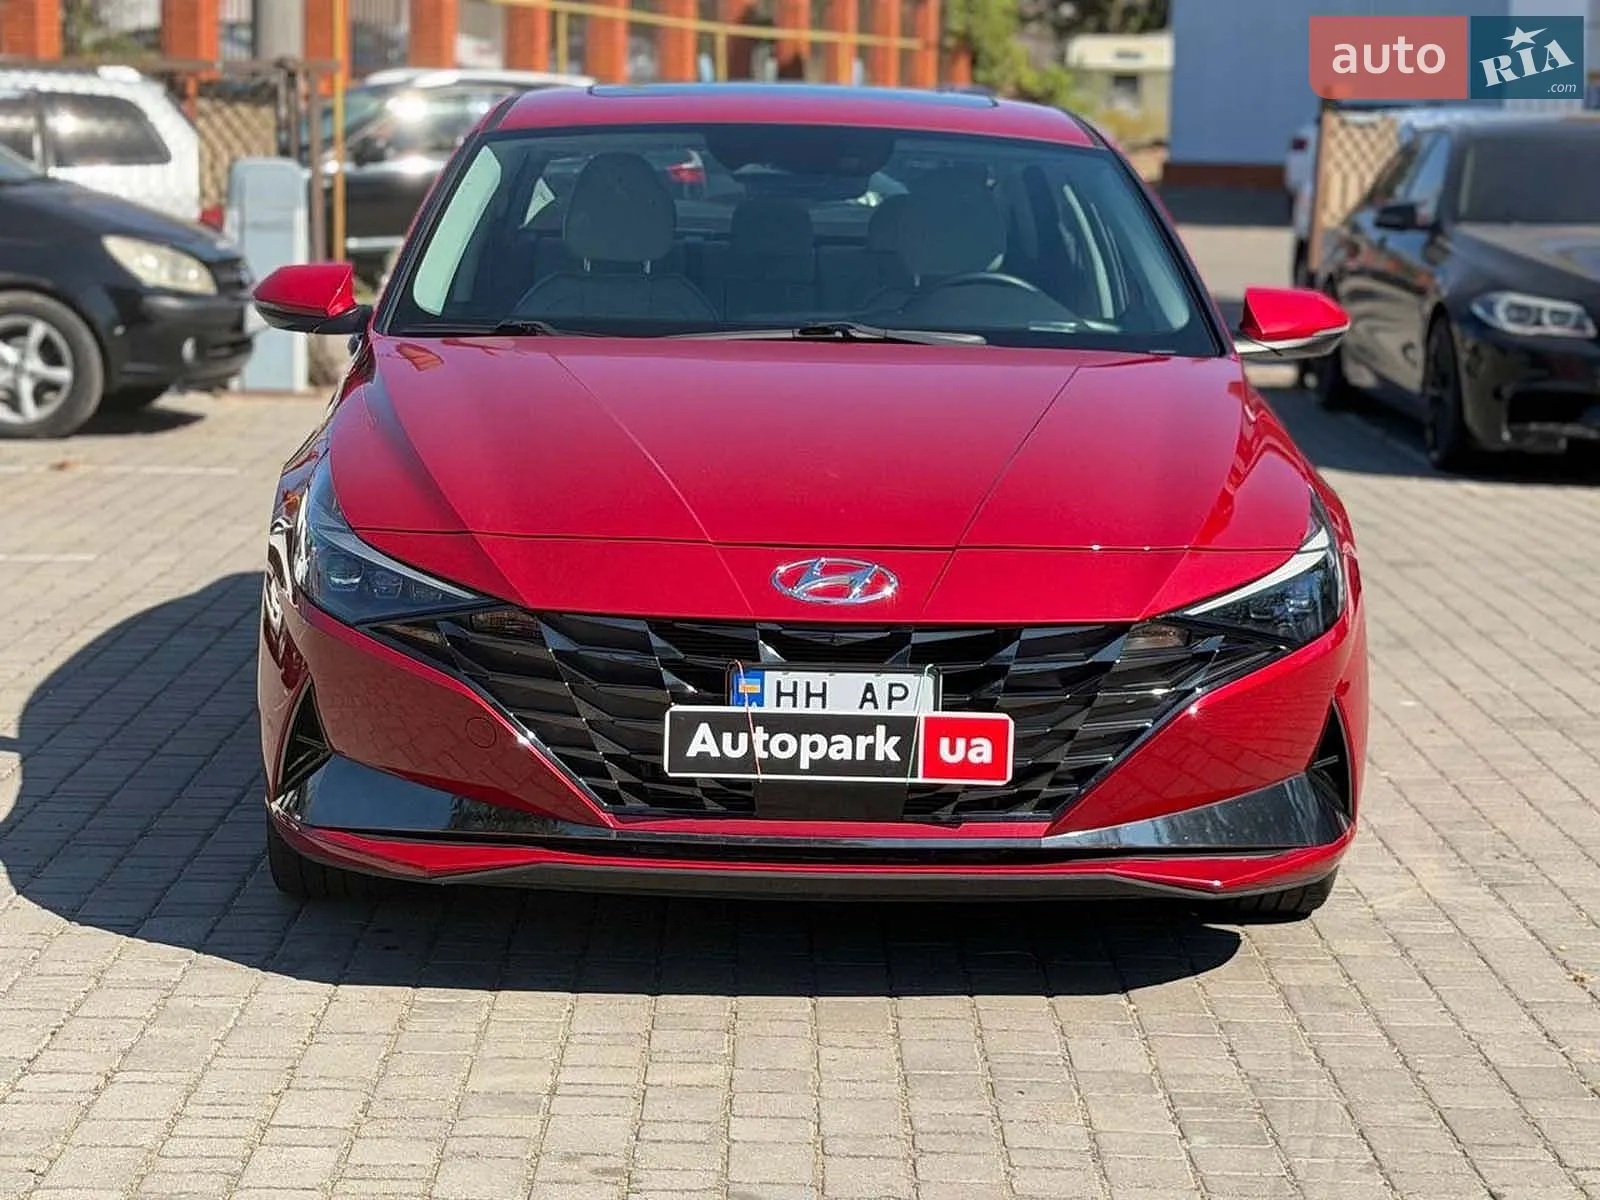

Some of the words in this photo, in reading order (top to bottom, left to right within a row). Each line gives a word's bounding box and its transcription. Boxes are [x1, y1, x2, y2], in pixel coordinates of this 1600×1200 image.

[775, 680, 828, 709] HH
[858, 682, 910, 710] AP
[685, 722, 901, 769] Autopark
[938, 736, 993, 764] ua
